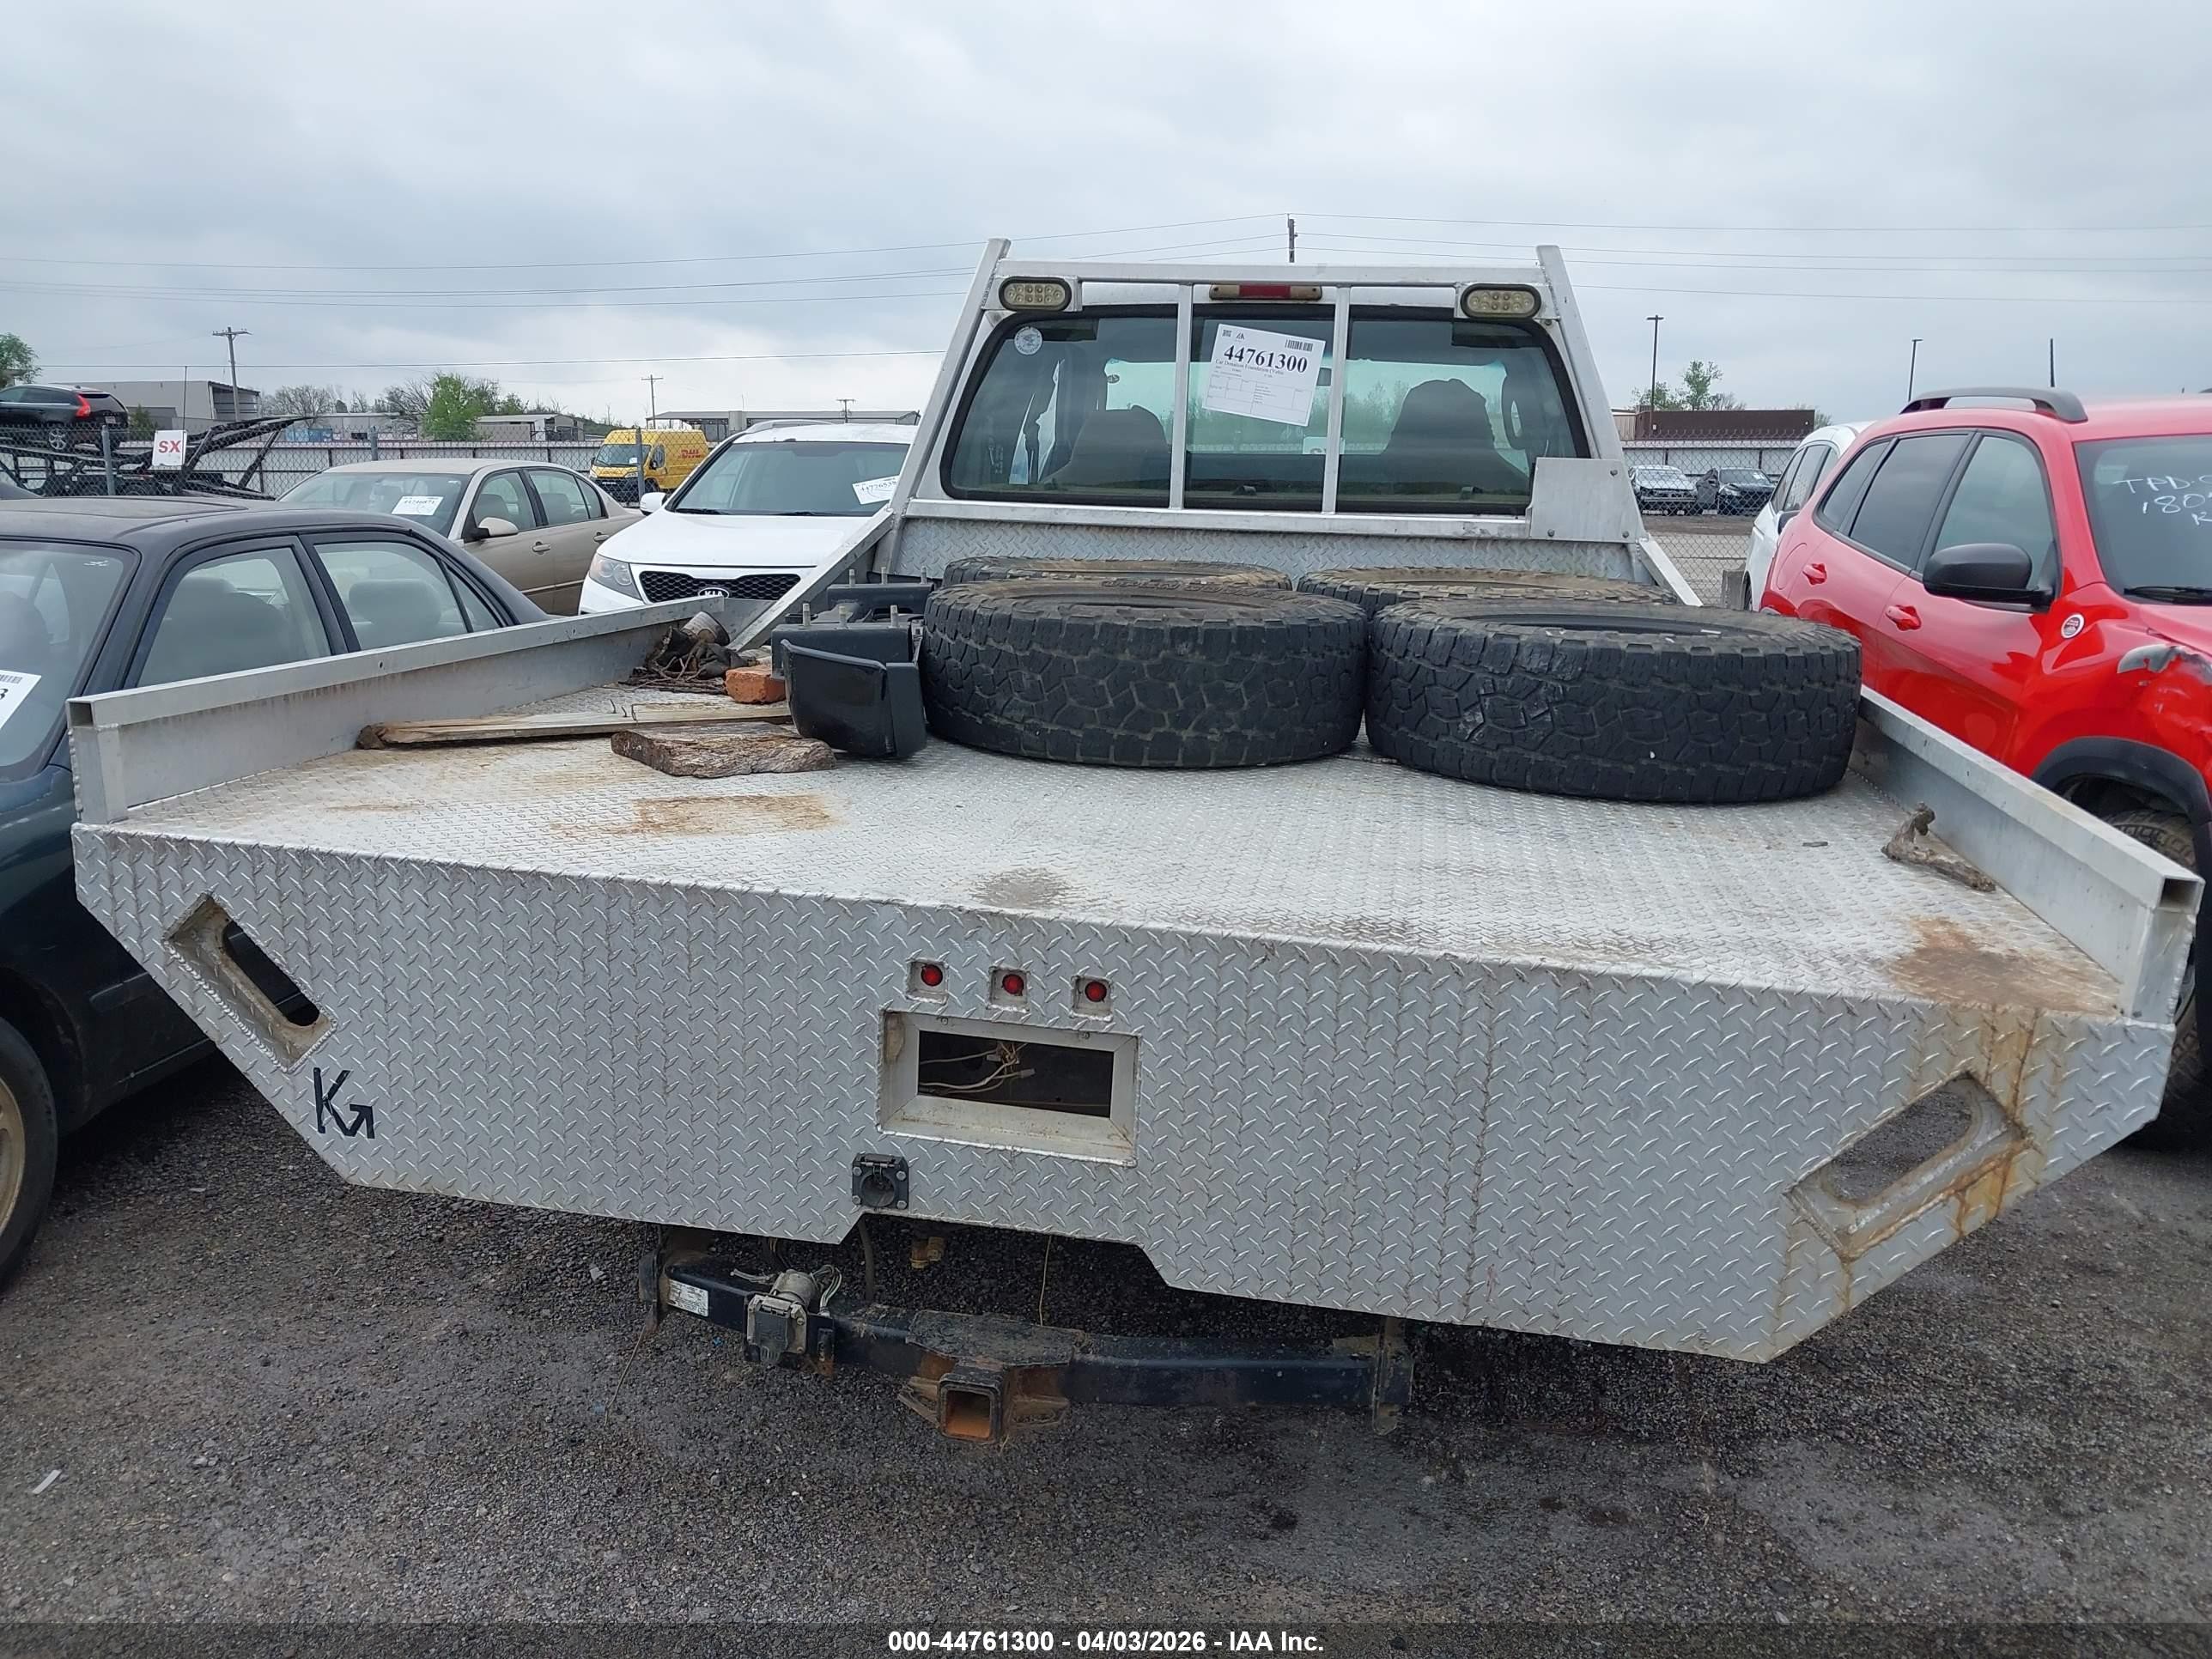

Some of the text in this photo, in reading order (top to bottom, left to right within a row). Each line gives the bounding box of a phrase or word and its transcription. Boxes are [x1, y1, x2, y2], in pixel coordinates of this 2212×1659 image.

[1224, 345, 1308, 374] 44761300
[158, 440, 181, 453] SX
[2143, 493, 2212, 514] 180
